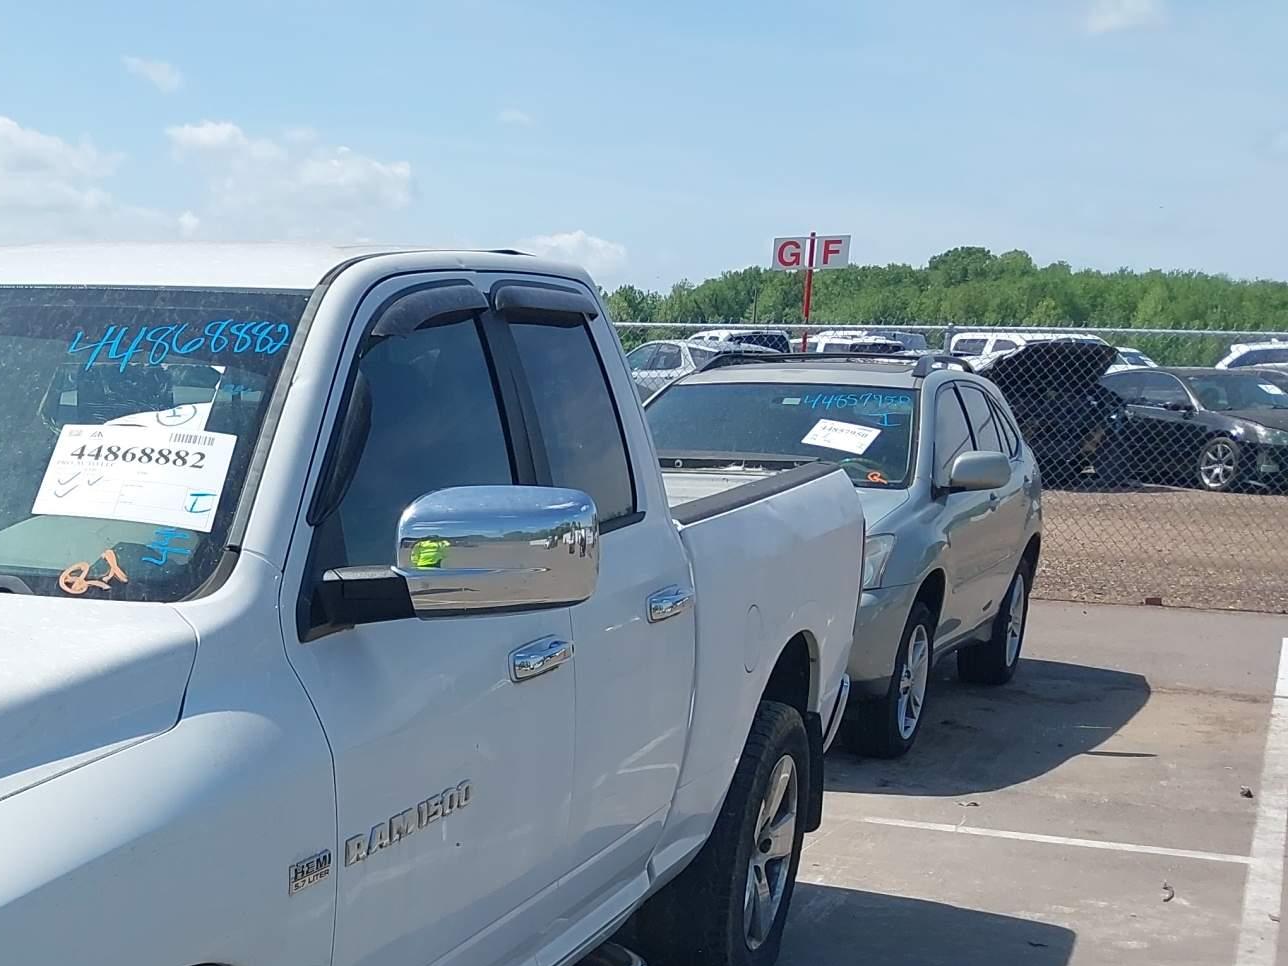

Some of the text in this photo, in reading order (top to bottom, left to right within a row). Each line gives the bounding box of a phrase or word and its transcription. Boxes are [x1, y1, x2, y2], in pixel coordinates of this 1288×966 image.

[777, 239, 842, 267] G F
[68, 319, 290, 374] 44868882
[70, 444, 206, 469] 44868882
[345, 779, 474, 867] RAM 1500
[294, 852, 332, 881] HEMI
[308, 868, 330, 884] LITER
